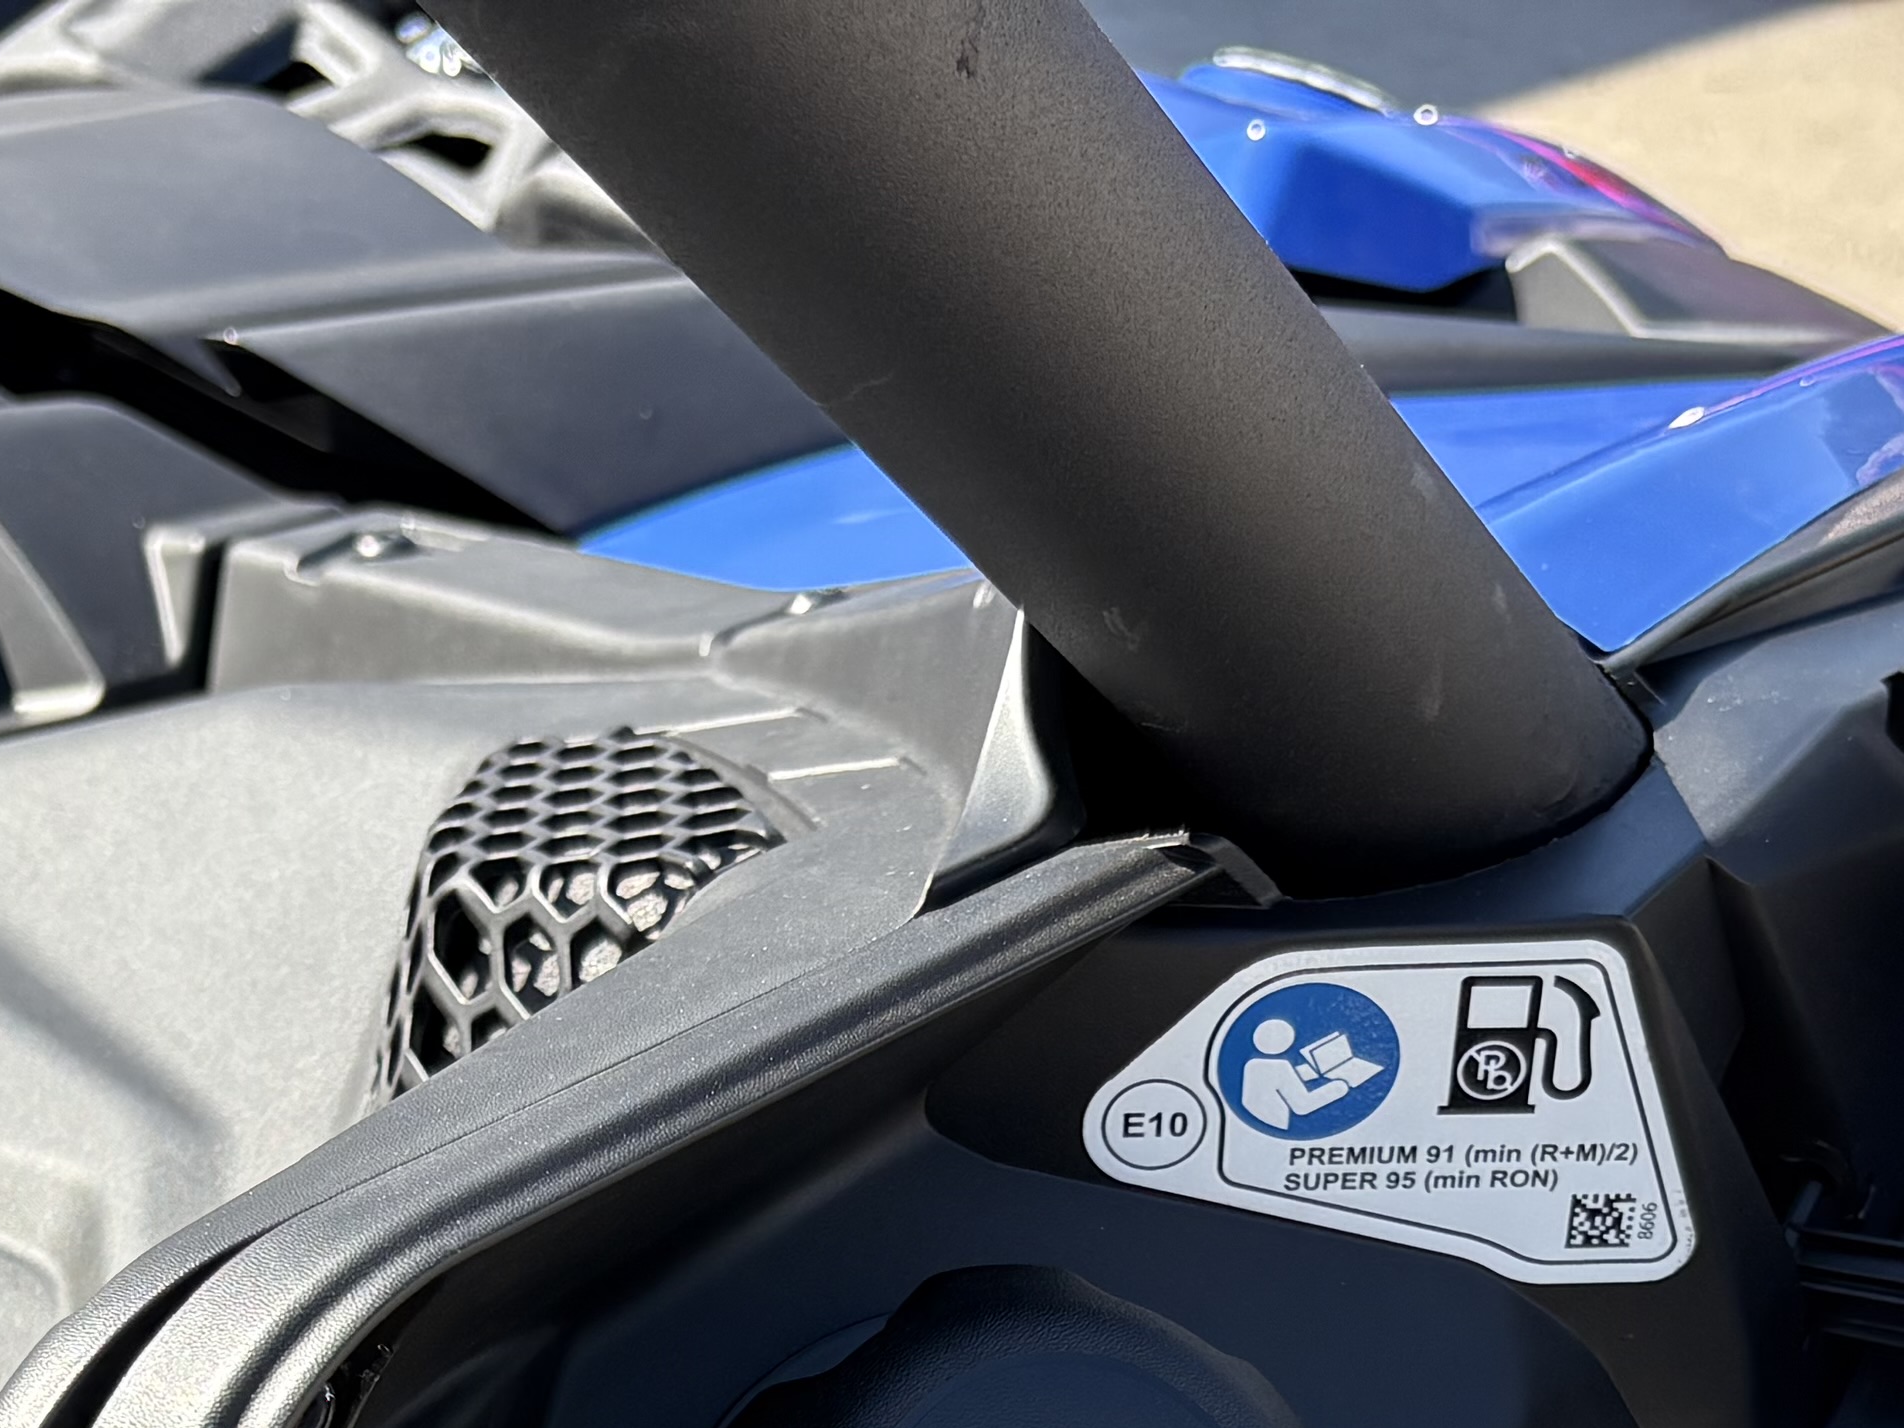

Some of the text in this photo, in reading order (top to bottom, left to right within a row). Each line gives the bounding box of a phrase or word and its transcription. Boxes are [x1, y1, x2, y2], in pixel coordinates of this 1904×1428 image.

[1122, 1111, 1189, 1138] E10
[1288, 1142, 1639, 1168] PREMIUM 91 (min (R+M)/2)
[1283, 1169, 1559, 1194] SUPER 95 (min RON)
[1637, 1202, 1658, 1240] 8606
